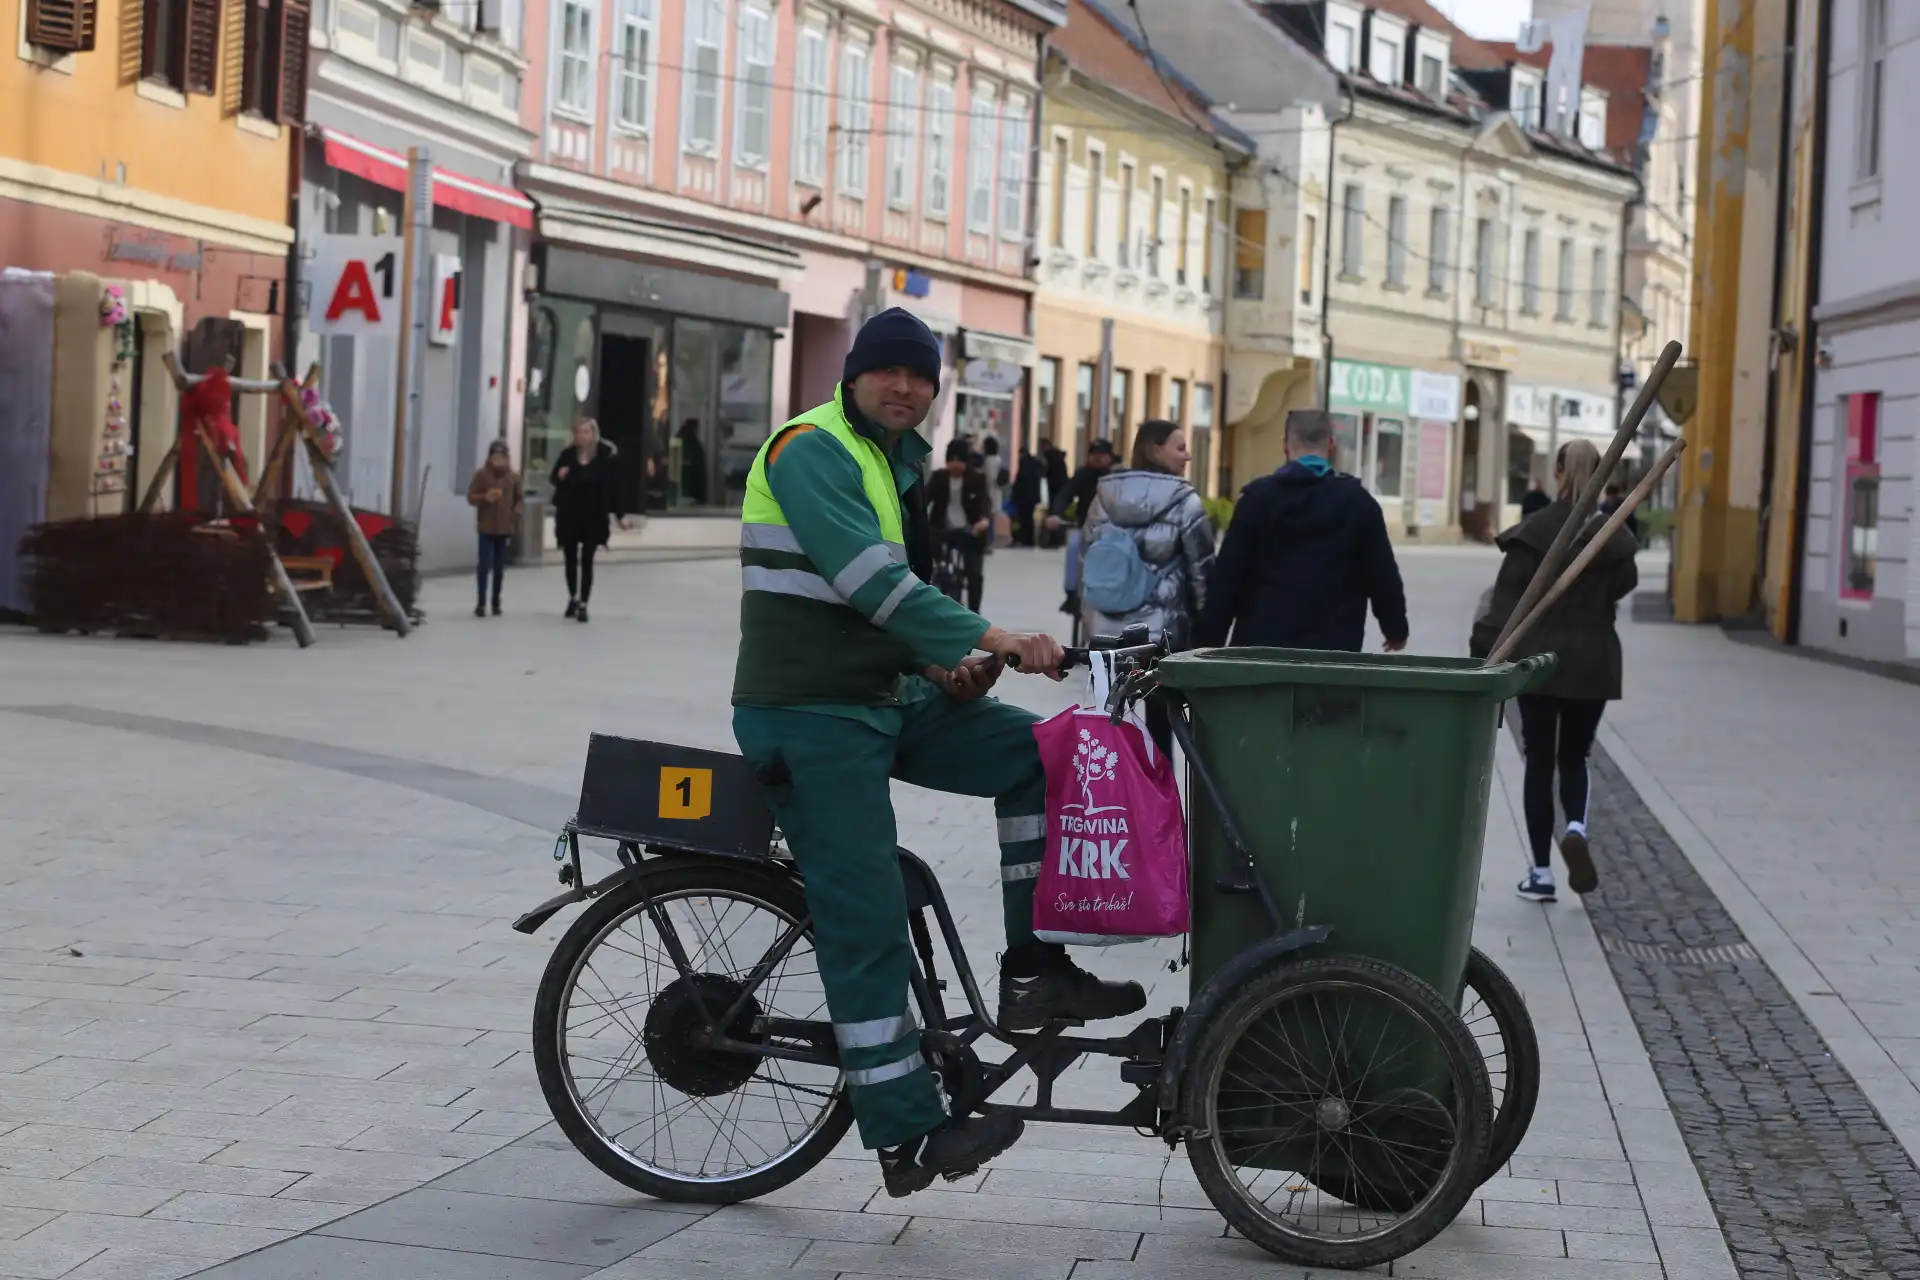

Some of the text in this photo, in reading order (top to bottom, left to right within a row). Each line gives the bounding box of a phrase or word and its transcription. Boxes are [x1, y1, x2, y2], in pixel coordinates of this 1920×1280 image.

[325, 252, 395, 322] A1
[675, 776, 691, 807] 1
[1058, 836, 1131, 879] KRK
[1055, 892, 1076, 912] Sve
[1078, 896, 1091, 912] što
